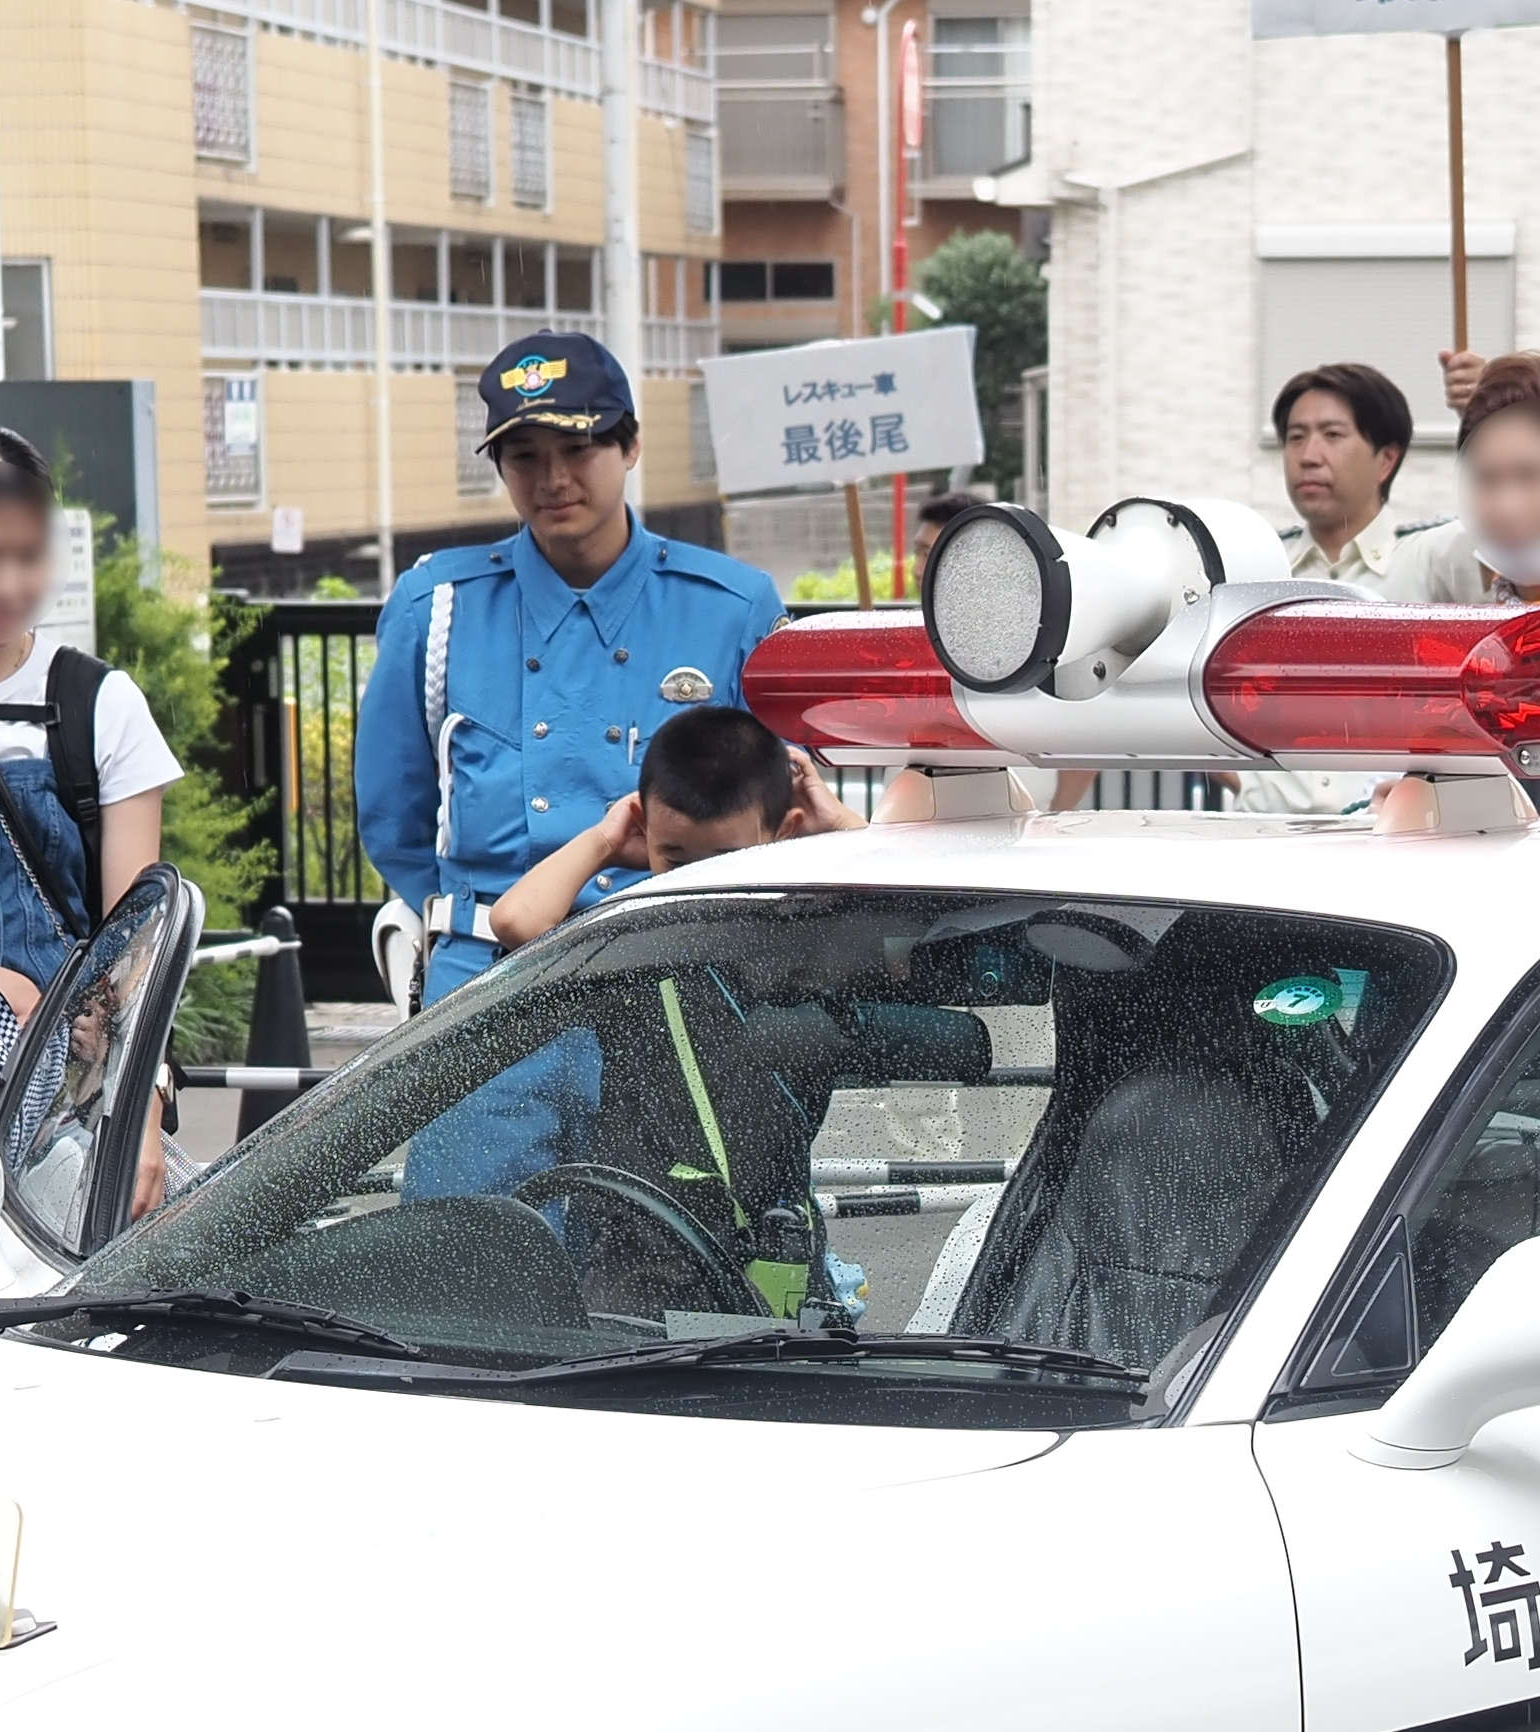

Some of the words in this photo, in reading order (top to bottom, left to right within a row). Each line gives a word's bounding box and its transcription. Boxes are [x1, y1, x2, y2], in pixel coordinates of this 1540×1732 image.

[783, 371, 896, 406] レスキュー車
[781, 413, 909, 466] 最後尾
